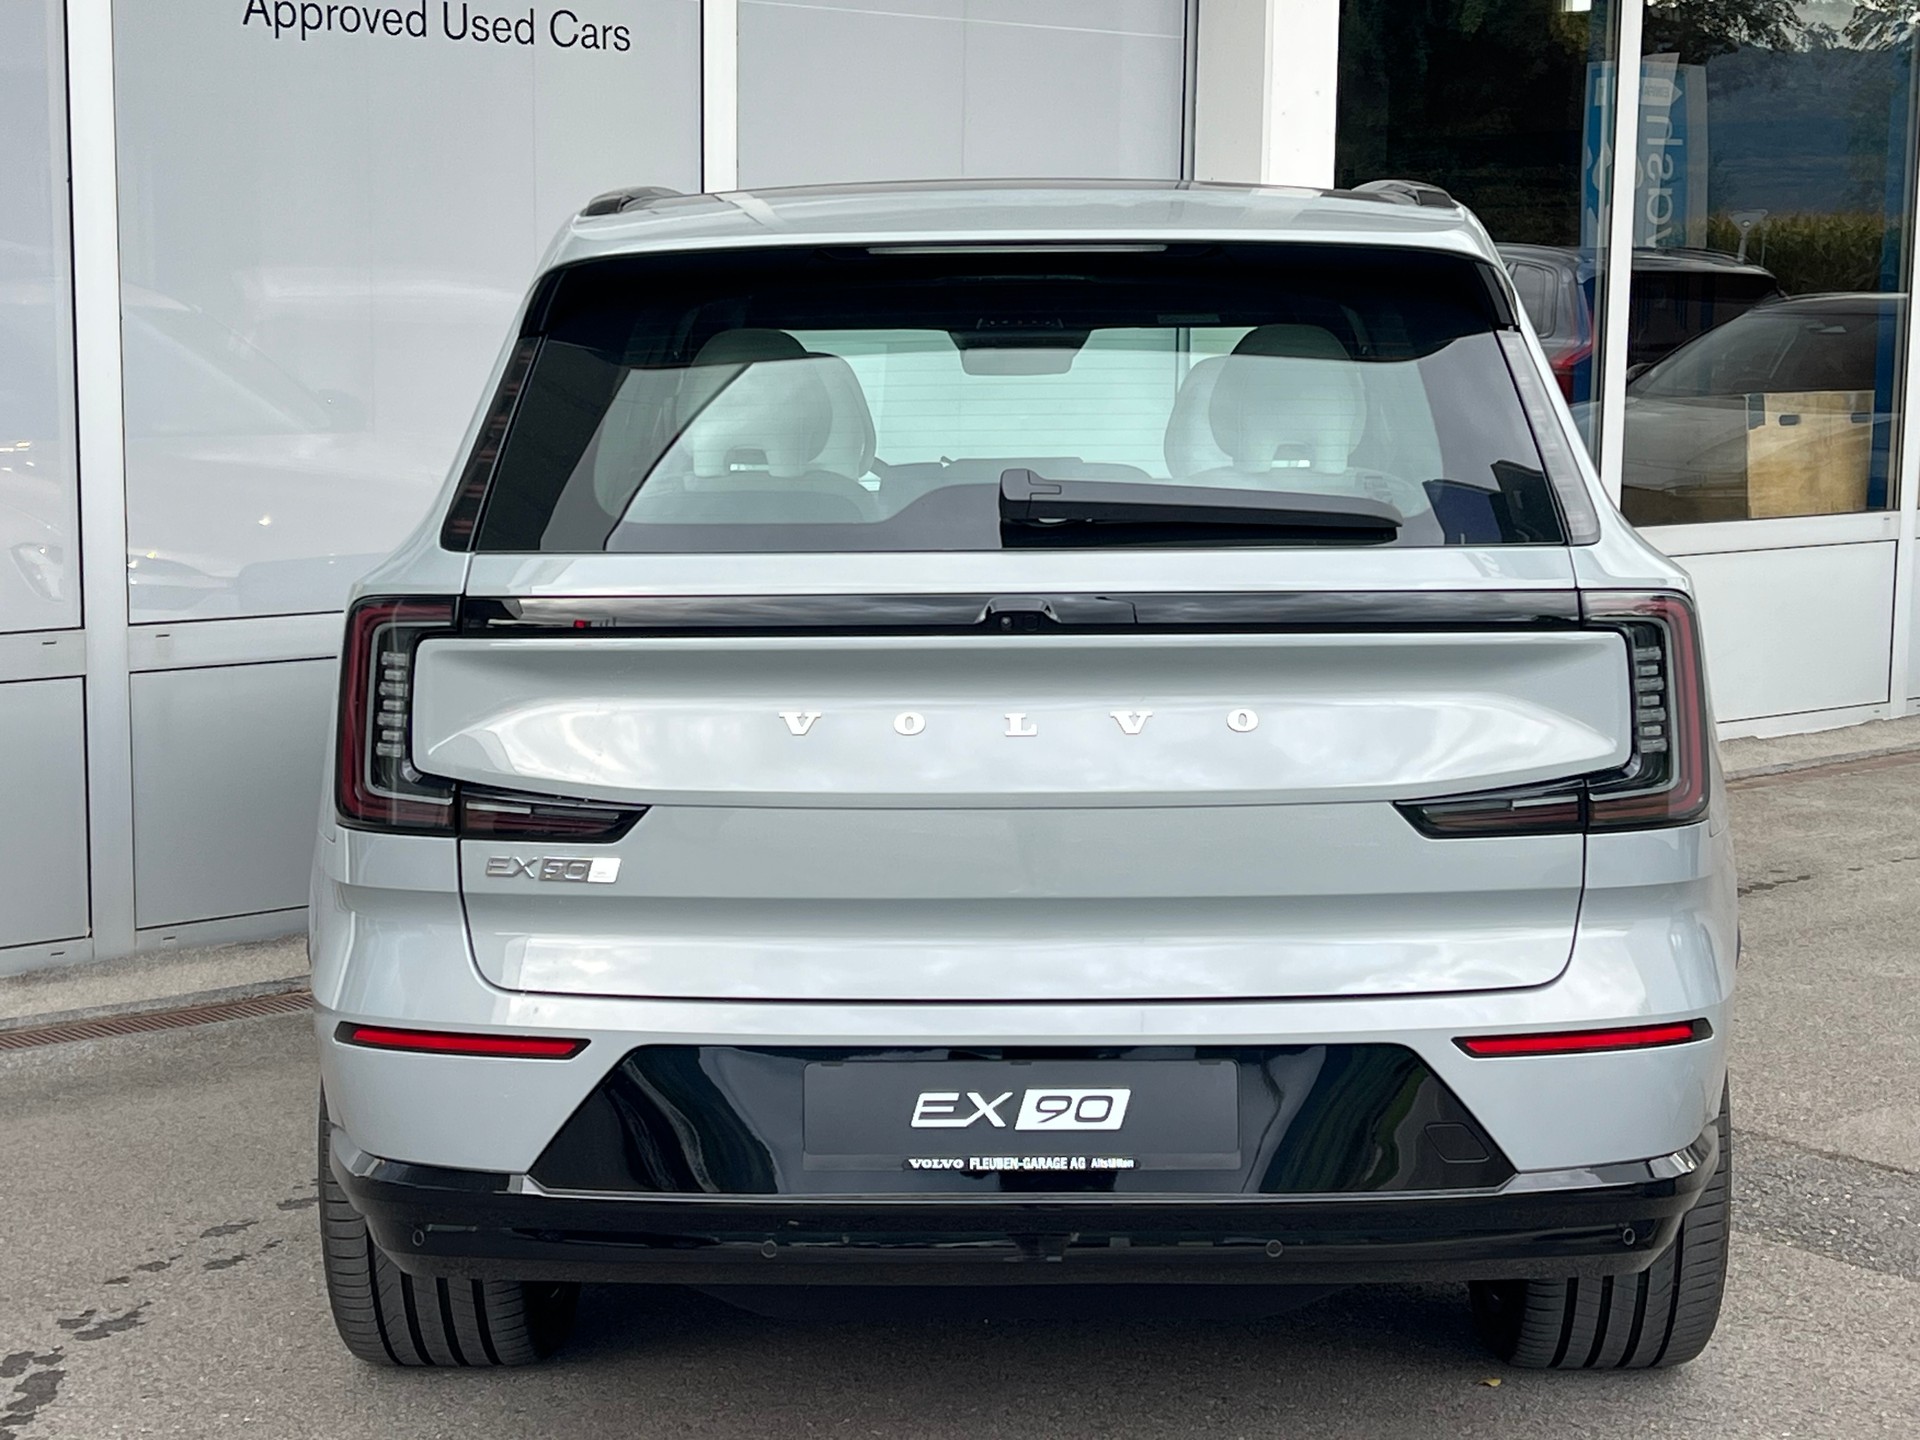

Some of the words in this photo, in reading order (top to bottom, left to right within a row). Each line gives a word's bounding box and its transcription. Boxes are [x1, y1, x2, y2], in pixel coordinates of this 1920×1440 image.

[243, 0, 427, 41] Approved
[443, 1, 535, 45] Used
[550, 10, 631, 51] Cars
[778, 707, 1260, 738] VOLVO
[908, 1158, 964, 1170] VOLVO
[1070, 1157, 1086, 1170] AG
